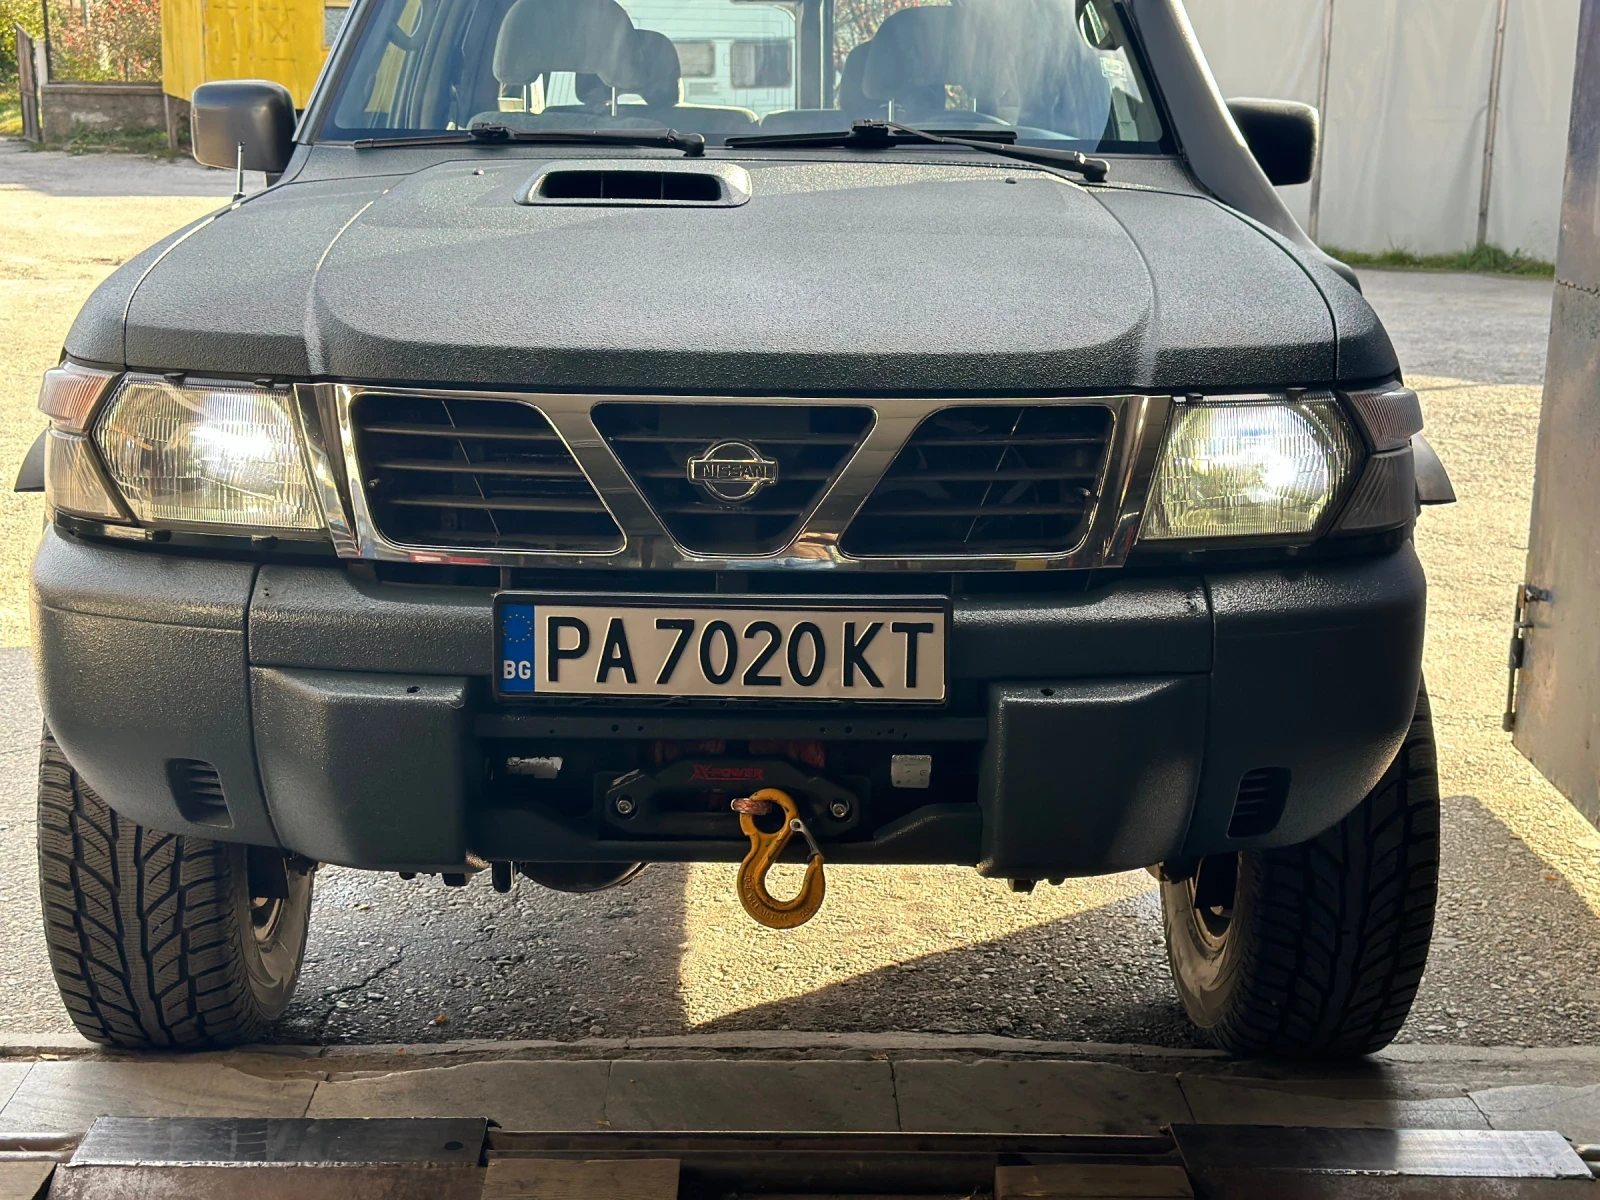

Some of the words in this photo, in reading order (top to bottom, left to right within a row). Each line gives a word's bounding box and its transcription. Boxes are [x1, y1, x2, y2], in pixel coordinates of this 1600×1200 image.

[702, 463, 768, 479] NISSAN
[547, 616, 638, 684] PA
[655, 618, 826, 686] 7020
[842, 621, 935, 689] KT
[503, 660, 531, 680] BG
